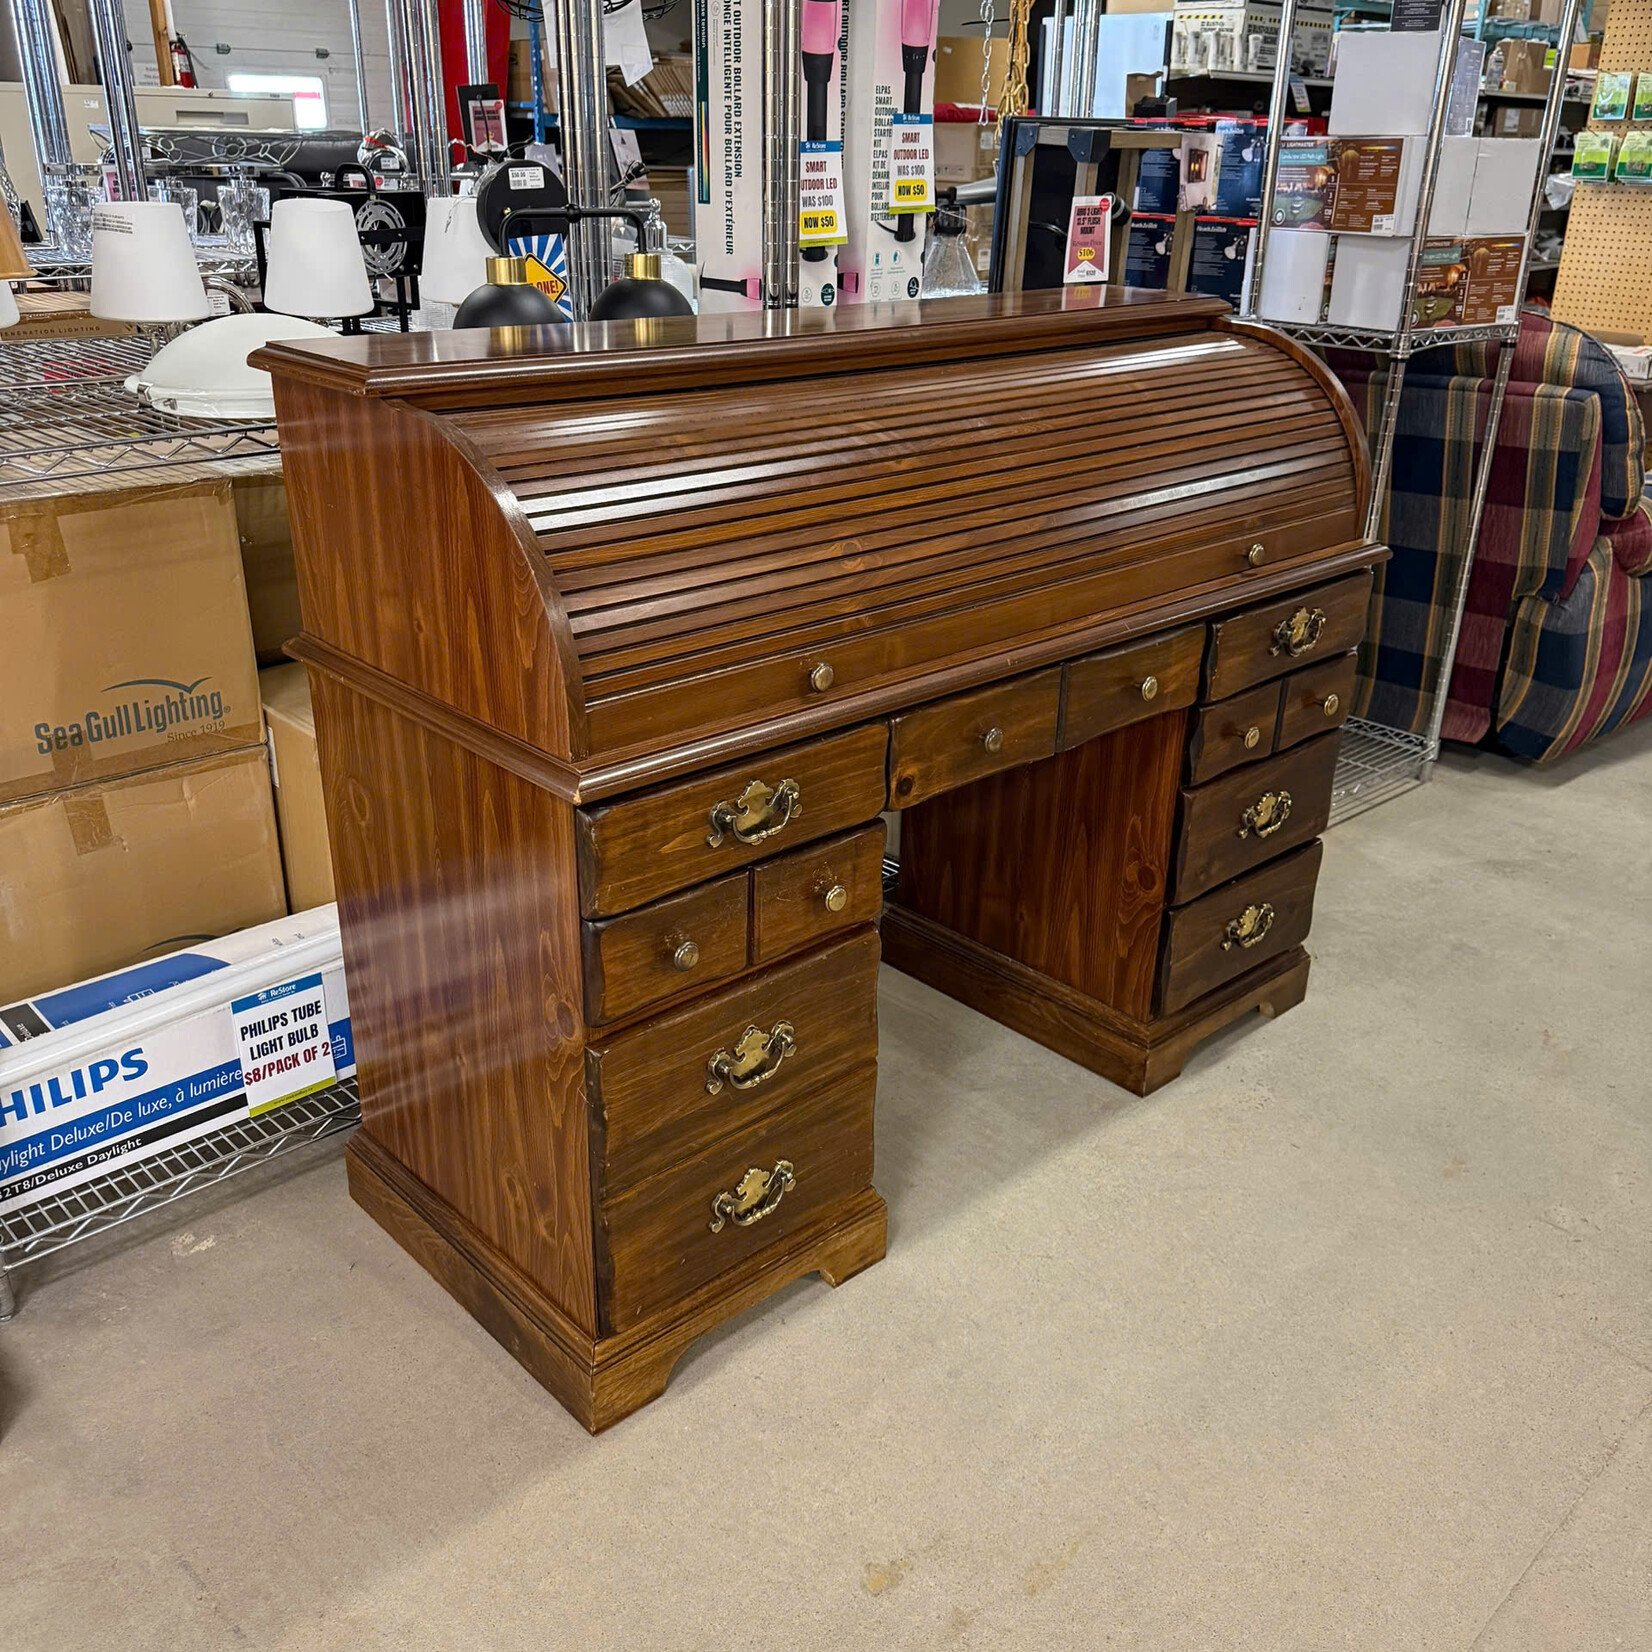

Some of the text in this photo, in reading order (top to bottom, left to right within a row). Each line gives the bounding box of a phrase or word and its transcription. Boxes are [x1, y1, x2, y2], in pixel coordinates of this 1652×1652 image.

[733, 10, 742, 63] OUTDOOR
[723, 29, 732, 101] INTELLIGENTE
[733, 67, 742, 117] BOLLARD
[875, 85, 891, 94] ELPAS
[875, 96, 893, 105] SMART
[724, 104, 732, 135] POUR
[873, 128, 892, 137] STARTE
[902, 132, 920, 143] SMART
[733, 121, 742, 178] EXTENSION
[873, 139, 882, 148] KIT
[873, 149, 888, 159] ELPAS
[893, 148, 929, 160] OUTDOOR LED
[724, 137, 733, 187] BOLLARD
[805, 160, 827, 173] SMART
[872, 160, 886, 169] KIT DE
[897, 164, 925, 176] WAS $100
[800, 177, 838, 191] UTDOOR LED
[897, 185, 925, 196] NOW $50
[801, 195, 834, 207] WAS $100
[871, 191, 884, 200] POUR
[725, 190, 735, 255] D'EXTÉRIEUR
[803, 215, 834, 229] NOW $50
[1078, 248, 1094, 257] $106
[0, 326, 101, 338] ENERATION LIGHTING
[34, 690, 223, 754] Sea Gull Lighting
[167, 720, 226, 743] Since 1919
[270, 984, 296, 997] ReStore
[240, 1000, 322, 1041] PHILIPS TUBE
[249, 1023, 319, 1061] LIGHT BULB
[244, 1041, 331, 1086] $8/PACK OF 2
[0, 1047, 149, 1128] HILIPS
[0, 1142, 46, 1175] ylight
[51, 1111, 133, 1152] Deluxe/De
[138, 1095, 172, 1118] luxe,
[175, 1087, 185, 1104] à
[189, 1069, 243, 1098] lumière
[86, 1137, 142, 1165] Daylight
